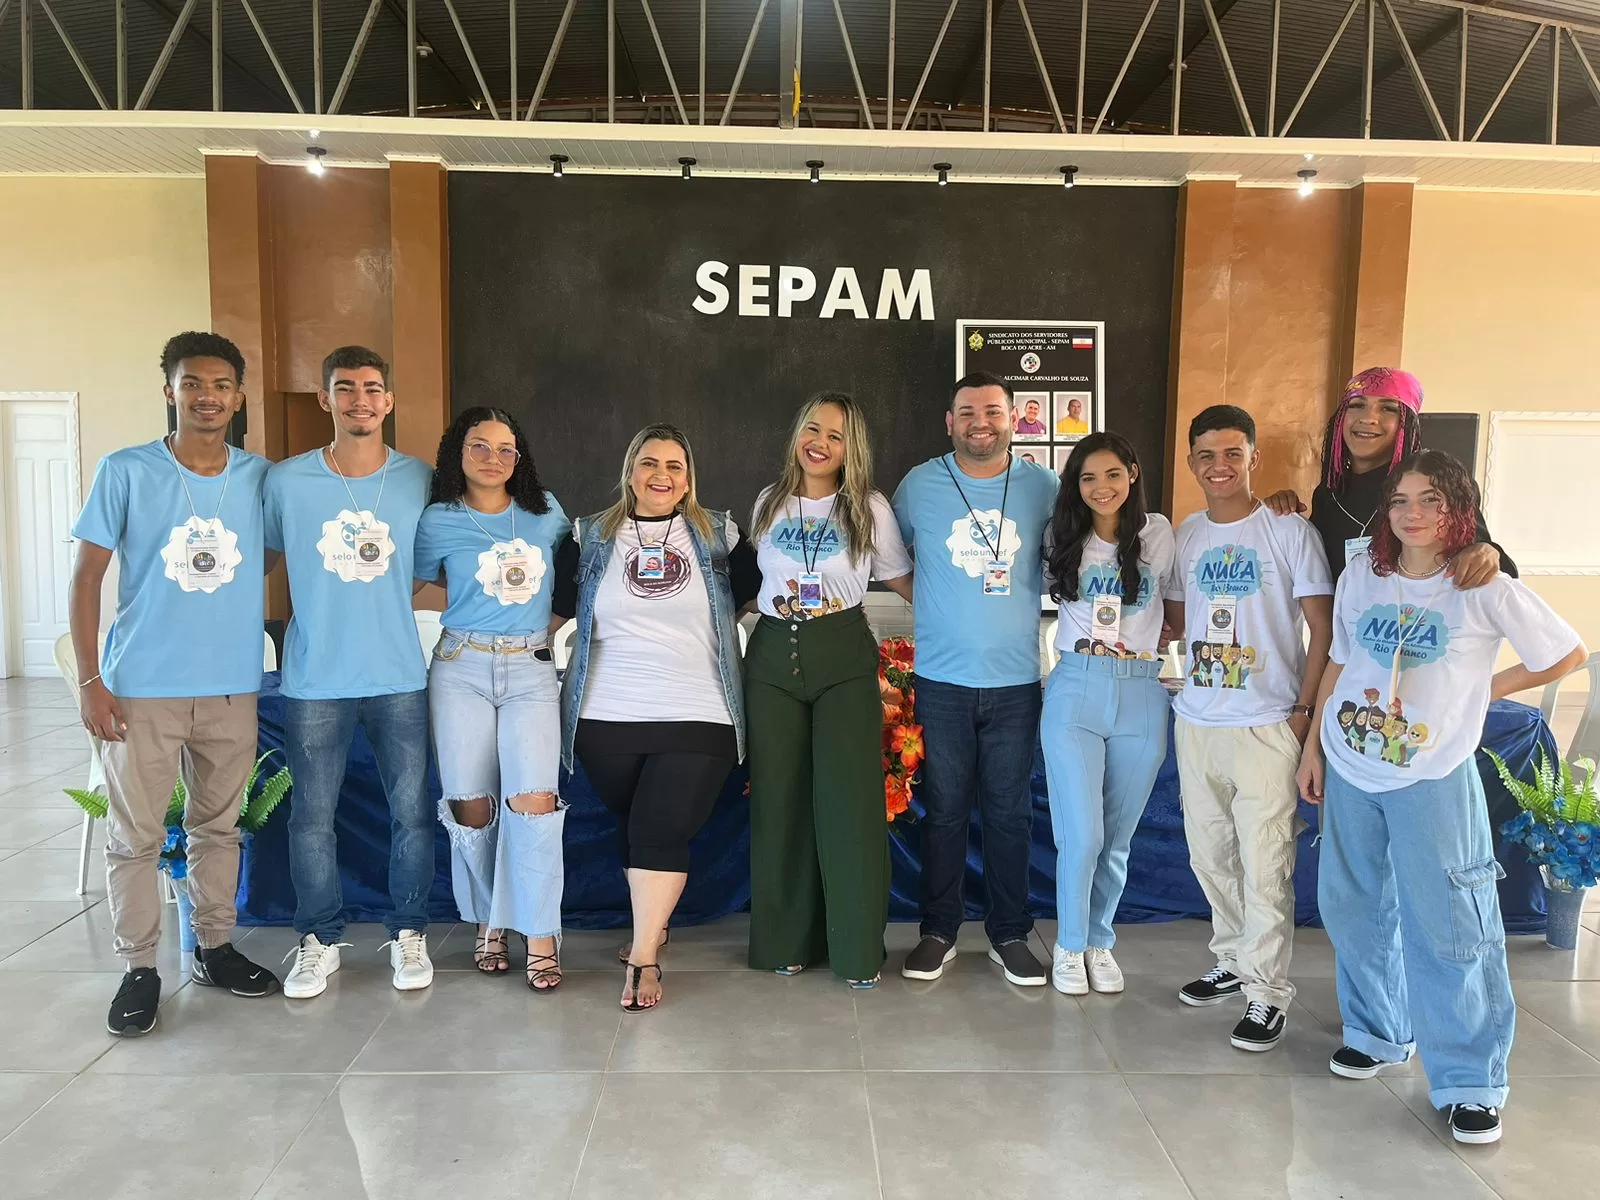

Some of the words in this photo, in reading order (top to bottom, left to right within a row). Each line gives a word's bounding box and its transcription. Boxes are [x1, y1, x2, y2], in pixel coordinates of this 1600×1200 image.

[692, 260, 935, 321] SEPAM
[987, 337, 1015, 345] PÚBLICOS
[778, 527, 839, 543] NUCA
[786, 543, 801, 551] Rio
[804, 545, 833, 553] Branco
[960, 549, 979, 557] selo
[980, 548, 1008, 557] unief
[332, 552, 352, 561] selo
[1201, 560, 1255, 581] NUCA
[1086, 576, 1149, 595] NUA
[1363, 617, 1438, 646] NUCA
[1373, 643, 1390, 654] Rio
